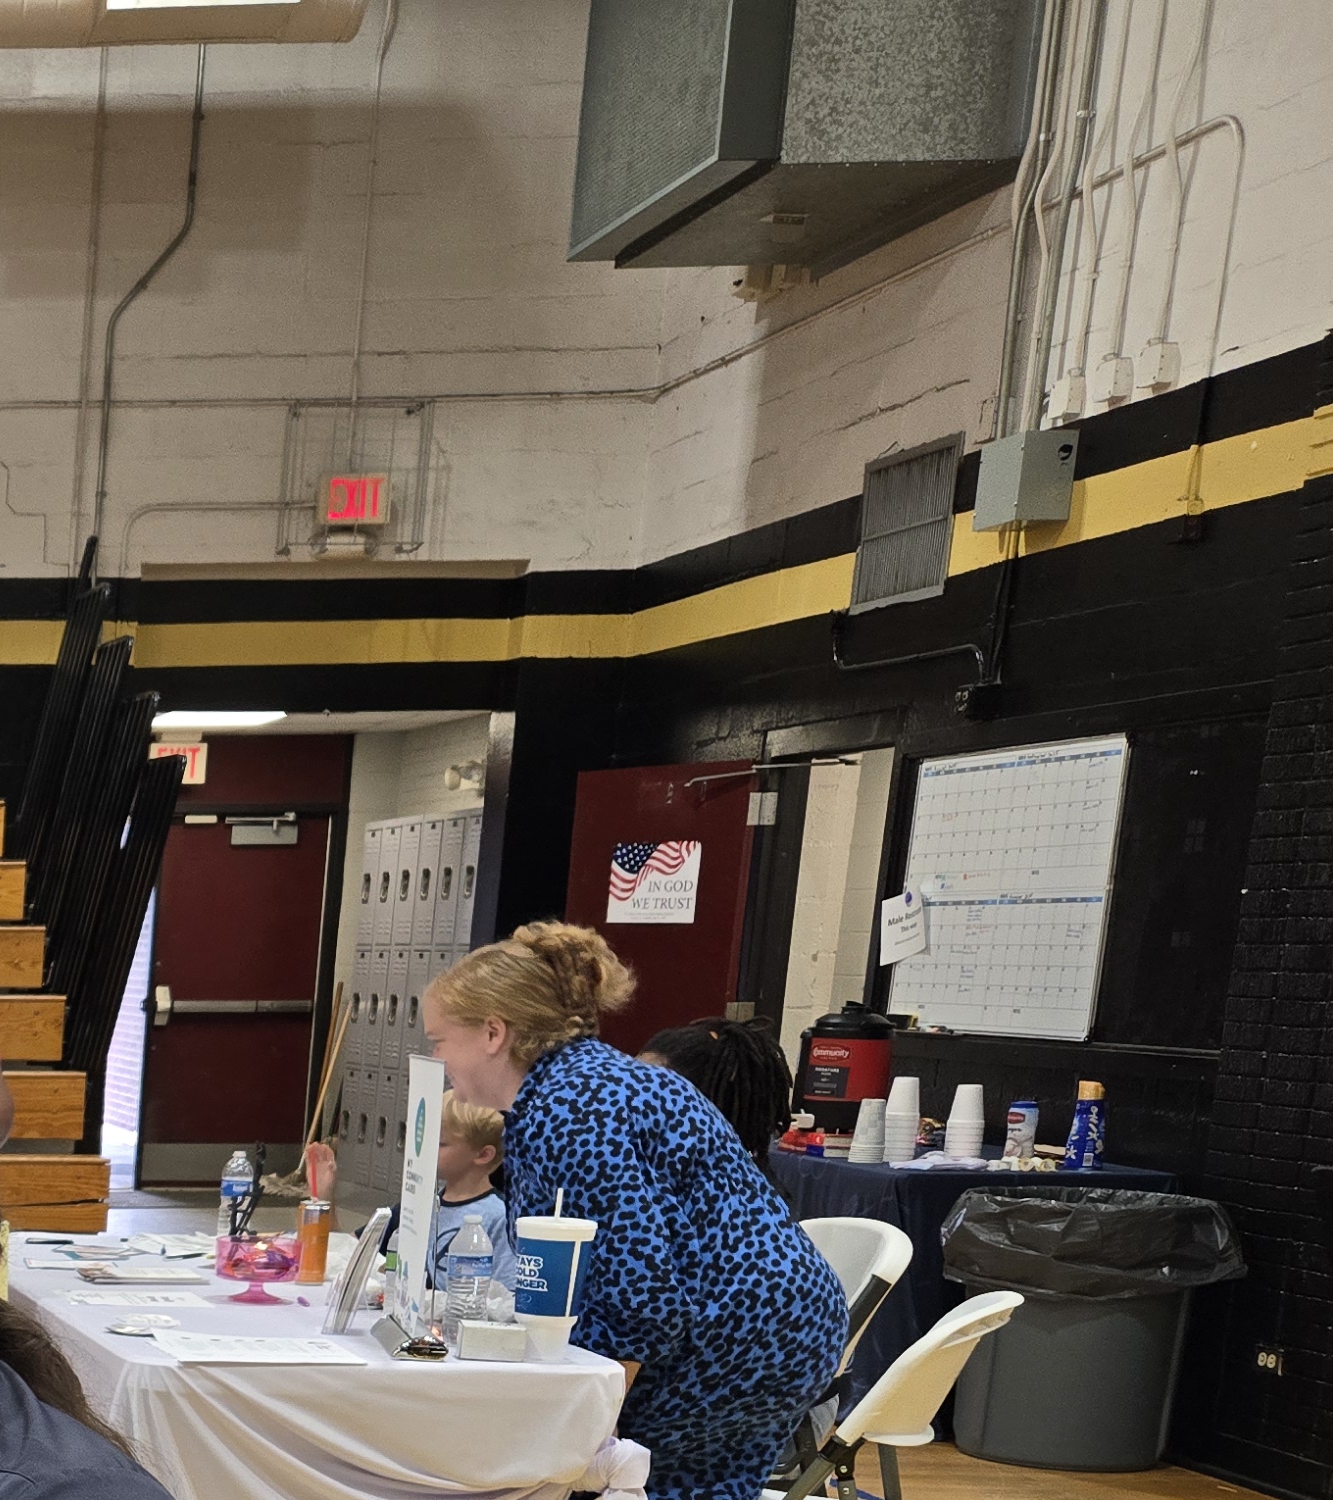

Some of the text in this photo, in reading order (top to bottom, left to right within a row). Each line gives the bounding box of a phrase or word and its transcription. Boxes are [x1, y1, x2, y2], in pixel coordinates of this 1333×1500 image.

[327, 477, 385, 519] EXIT
[648, 880, 694, 893] IN GOD
[632, 898, 693, 910] WE TRUST
